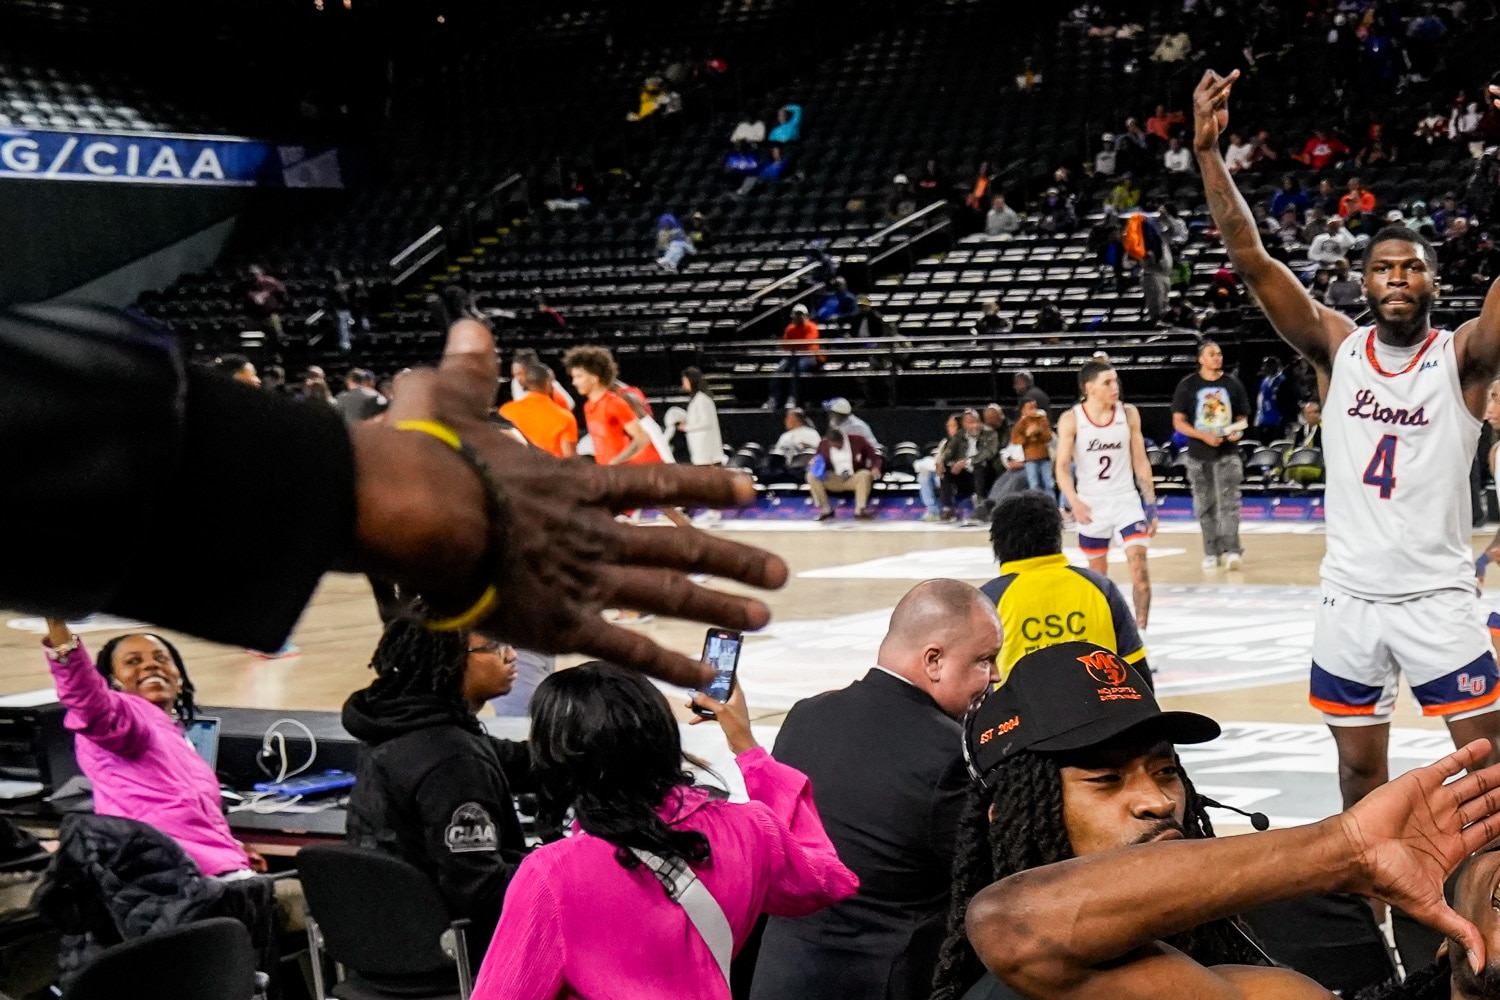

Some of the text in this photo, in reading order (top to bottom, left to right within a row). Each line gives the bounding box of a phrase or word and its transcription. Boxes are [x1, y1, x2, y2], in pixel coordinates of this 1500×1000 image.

[1348, 390, 1430, 426] Lions
[1098, 456, 1112, 480] 2
[1363, 434, 1398, 500] 4
[1022, 612, 1087, 642] CSC
[980, 716, 1021, 745] EST 2004
